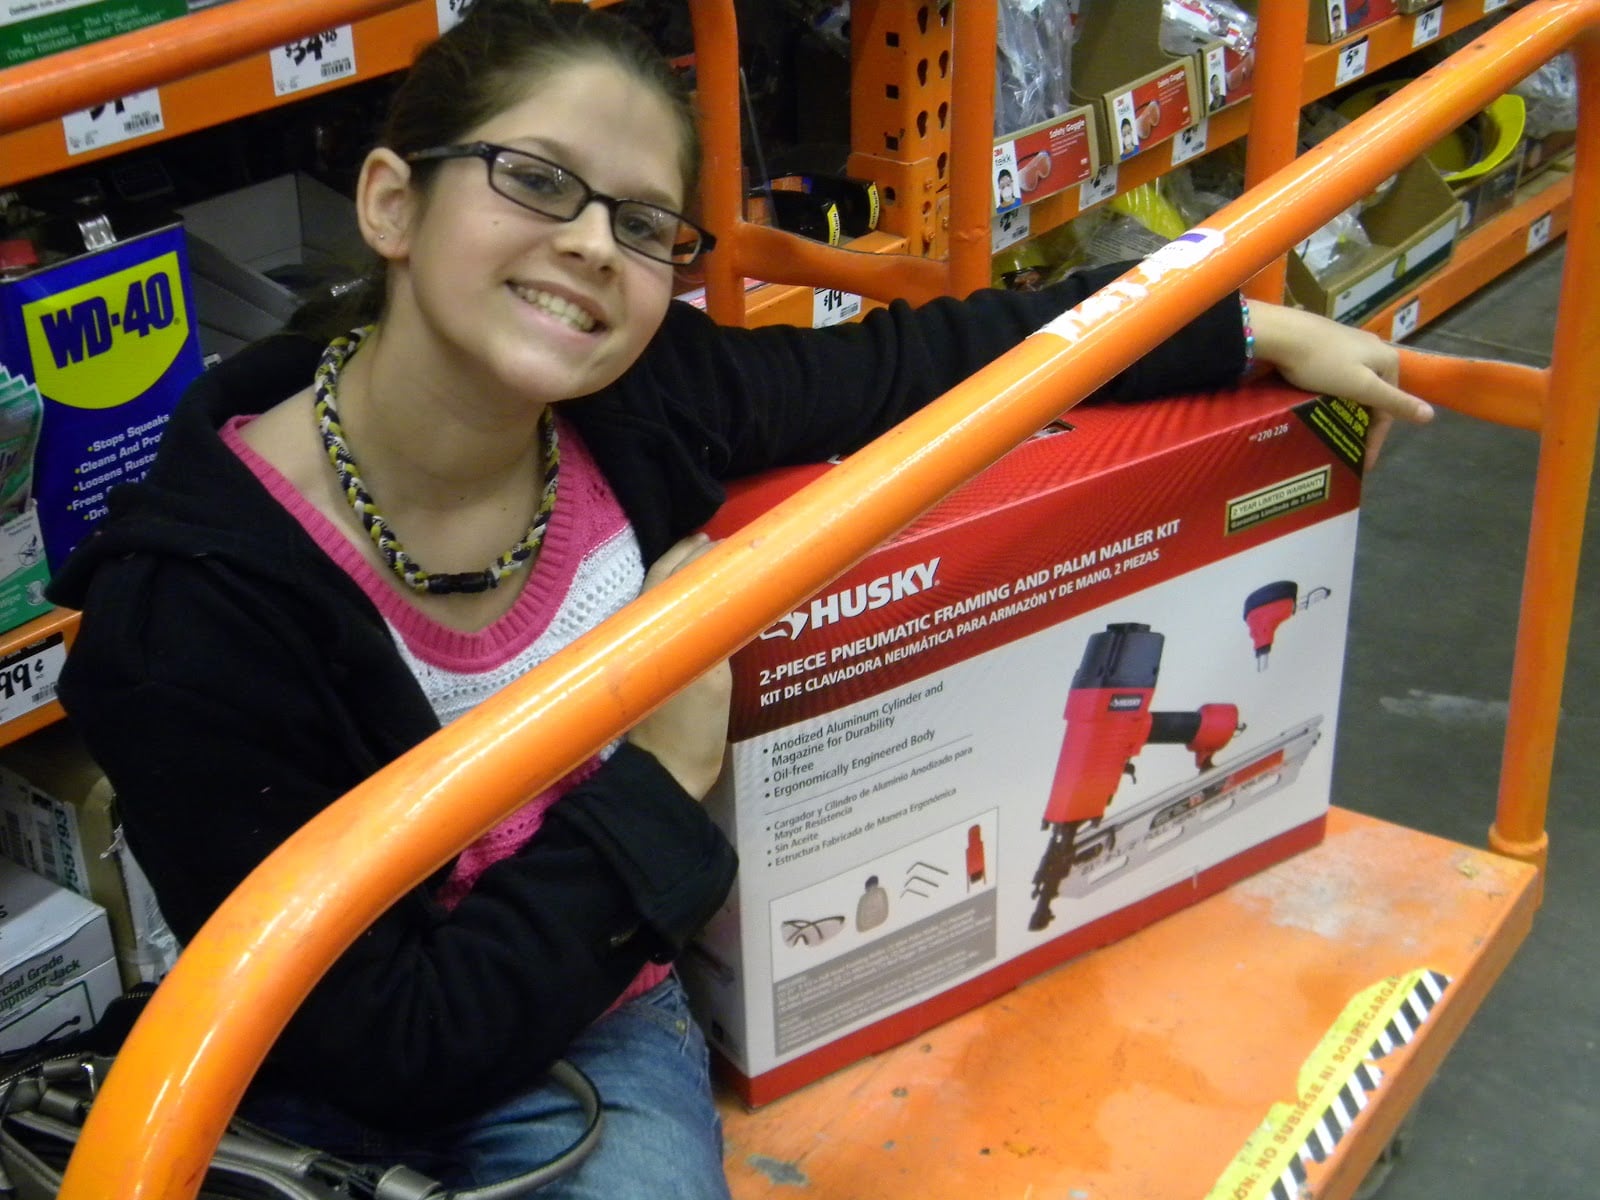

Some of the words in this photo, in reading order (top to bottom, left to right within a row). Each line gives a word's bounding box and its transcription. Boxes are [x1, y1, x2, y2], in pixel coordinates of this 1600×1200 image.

[1049, 126, 1066, 139] Safety
[1065, 120, 1085, 132] Goggle
[40, 272, 174, 369] WD-40
[93, 433, 125, 452] Stops
[127, 413, 170, 438] Squeaks
[1257, 429, 1273, 442] 270
[1274, 424, 1289, 437] 226
[80, 453, 117, 474] Cleans
[119, 442, 140, 458] And
[142, 432, 163, 448] Pro
[78, 467, 123, 491] Loosens
[1239, 502, 1257, 513] YEAR
[1258, 491, 1285, 506] LIMITED
[1286, 478, 1323, 497] WARRANTY
[72, 492, 103, 511] Frees
[89, 505, 109, 520] Dri
[760, 651, 827, 686] 2-PIECE
[831, 615, 931, 663] PNEUMATIC
[934, 585, 1010, 625] FRAMING
[1014, 571, 1050, 593] AND
[1053, 551, 1097, 579] PALM
[1100, 531, 1153, 560] NAILER
[1157, 519, 1181, 540] KIT
[811, 557, 941, 629] HUSKY
[761, 689, 781, 707] KIT
[784, 684, 802, 700] DE
[805, 659, 882, 693] CLAVADORA
[885, 628, 954, 665] NEUMÁTICA
[957, 616, 987, 637] PARA
[989, 593, 1047, 624] ARMAZÓN
[1049, 589, 1057, 600] Y
[1058, 583, 1074, 598] DE
[1076, 570, 1113, 590] MANO,
[1115, 564, 1121, 575] 2
[1123, 548, 1160, 573] PIEZAS
[772, 728, 824, 754] Anodized
[826, 711, 879, 736] Aluminum
[881, 693, 922, 717] Cylinder
[924, 682, 944, 698] and
[771, 744, 825, 768] Magazine
[827, 735, 843, 749] for
[845, 715, 896, 741] Durability
[773, 763, 849, 799] Ergonomically
[852, 743, 909, 769] Engineered
[910, 728, 936, 747] Body
[773, 761, 814, 783] Oil-free
[774, 810, 815, 831] Cargador
[817, 808, 823, 817] y
[824, 794, 858, 811] Cilindro
[860, 787, 871, 798] de
[872, 772, 908, 795] Aluminio
[910, 756, 953, 777] Anodizado
[955, 747, 973, 760] para
[774, 827, 803, 843] Mayor
[805, 806, 853, 831] Resistencia
[775, 842, 820, 867] Estructura
[822, 827, 863, 849] Fabricada
[864, 820, 875, 831] de
[877, 809, 908, 826] Manera
[775, 843, 789, 855] Sin
[790, 832, 819, 850] Aceite
[28, 955, 64, 981] Grade
[50, 960, 80, 981] Jack
[1255, 1147, 1278, 1171] NO
[1273, 1081, 1324, 1145] SUBIRSE
[1319, 1066, 1336, 1086] NI
[1332, 977, 1401, 1063] SOBRECARGA
